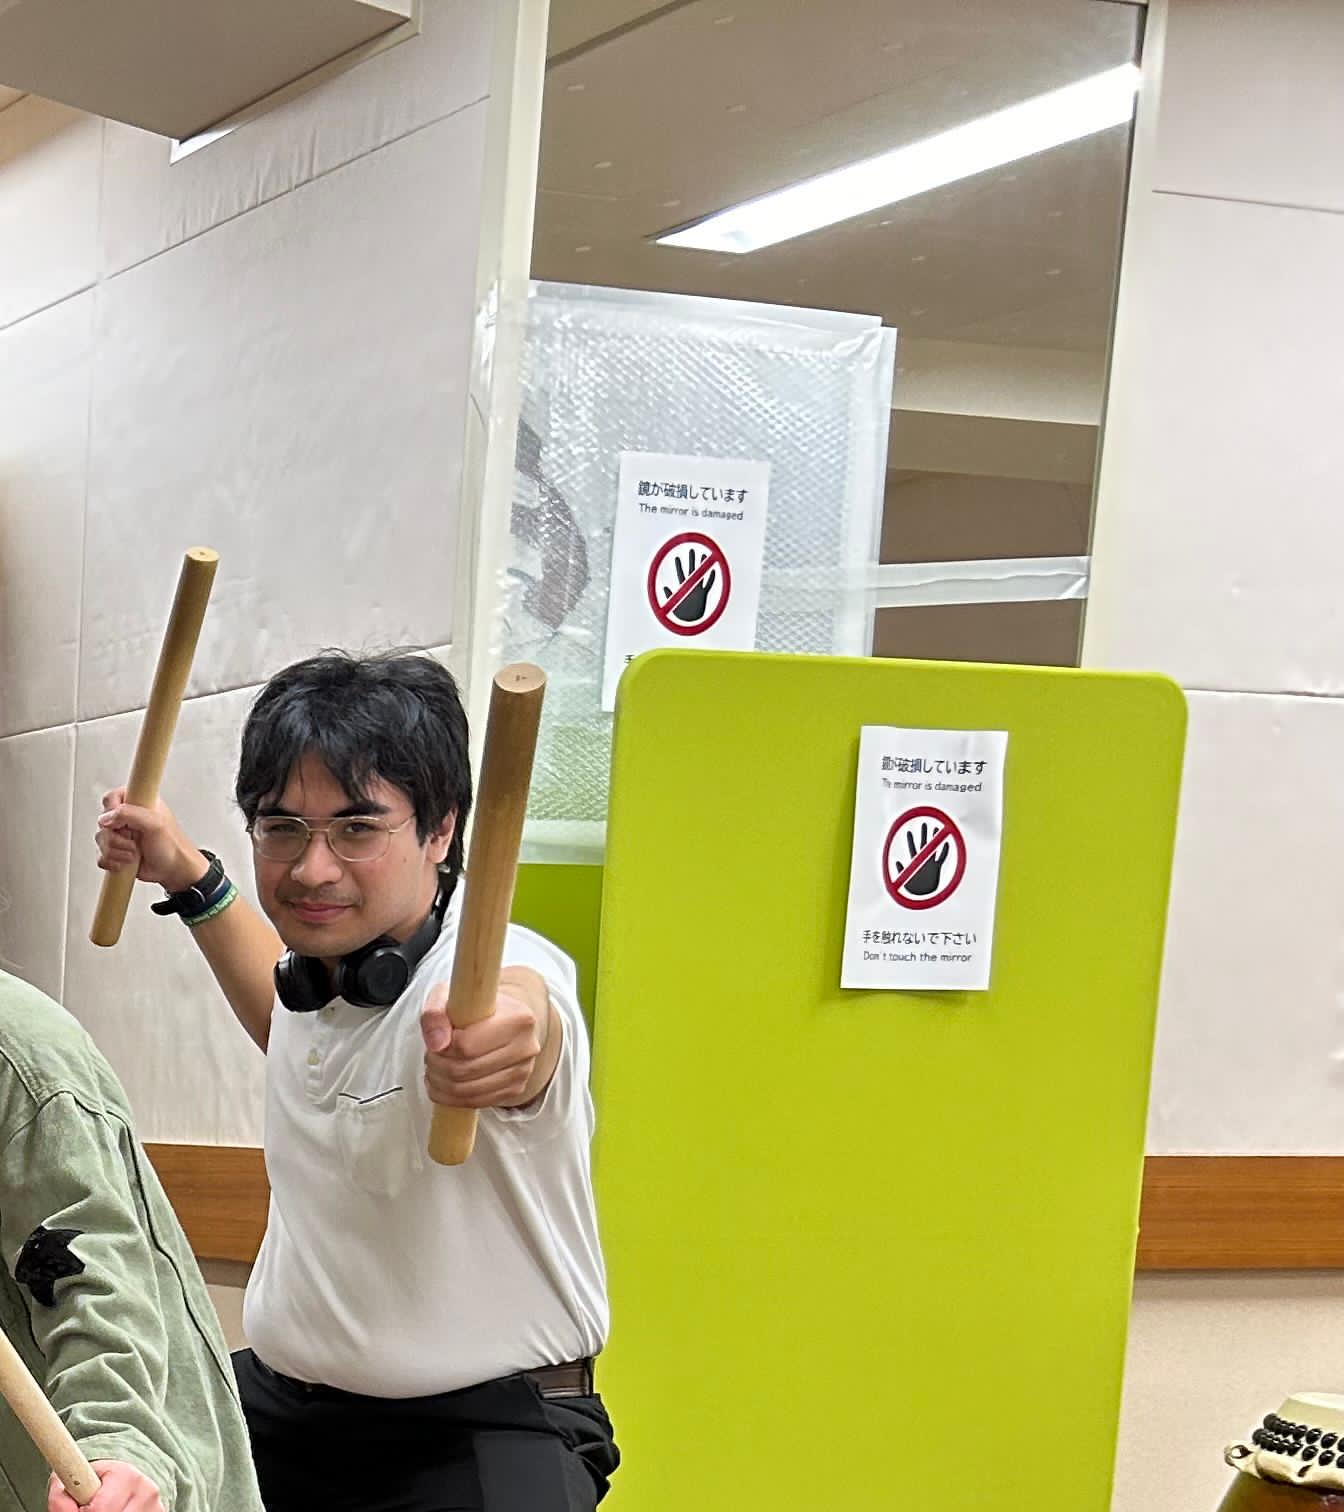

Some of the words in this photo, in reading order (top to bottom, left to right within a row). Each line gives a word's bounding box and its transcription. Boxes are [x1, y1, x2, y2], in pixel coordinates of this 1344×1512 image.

[640, 503, 657, 513] The
[660, 505, 688, 515] mirror
[692, 506, 699, 516] is
[702, 507, 744, 520] damaged
[925, 782, 932, 790] is
[935, 781, 982, 792] damaged
[889, 951, 916, 961] touch
[920, 951, 937, 961] the
[940, 953, 972, 962] mirror
